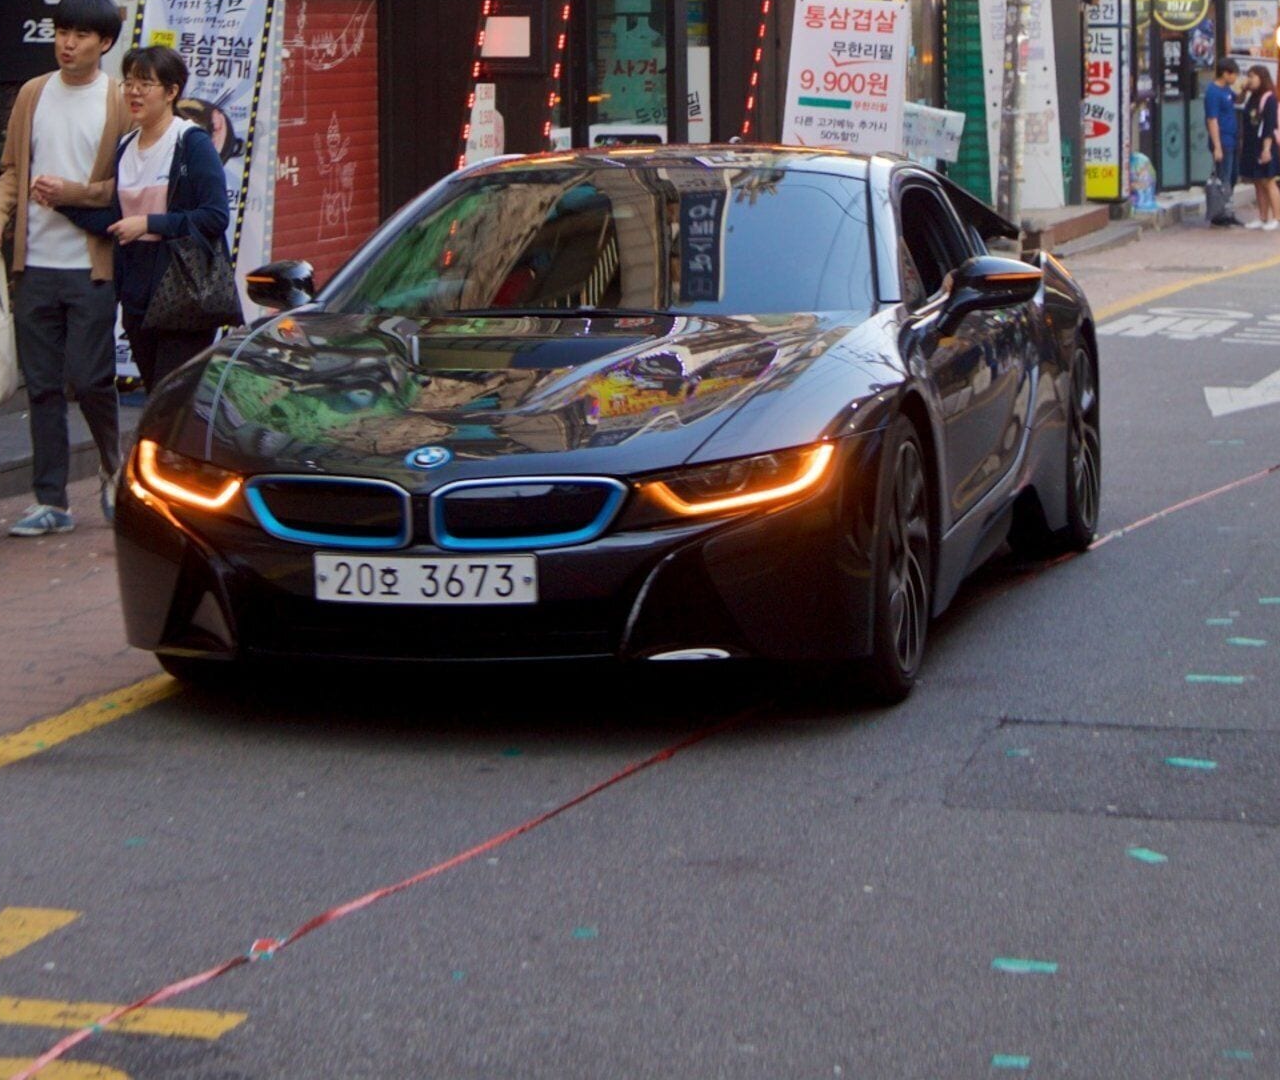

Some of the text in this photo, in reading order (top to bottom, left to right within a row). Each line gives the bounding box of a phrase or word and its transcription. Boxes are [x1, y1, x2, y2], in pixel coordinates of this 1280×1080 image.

[803, 4, 898, 34] 통삼겹살
[178, 32, 254, 57] 통삼겹살
[831, 40, 894, 61] 무한리필
[184, 56, 253, 81] 장찌개
[799, 68, 889, 97] 9,900원
[794, 115, 889, 133] 다른 고기메뉴 추가시
[820, 128, 860, 144] 50%할인
[334, 561, 516, 598] 20호 3673
